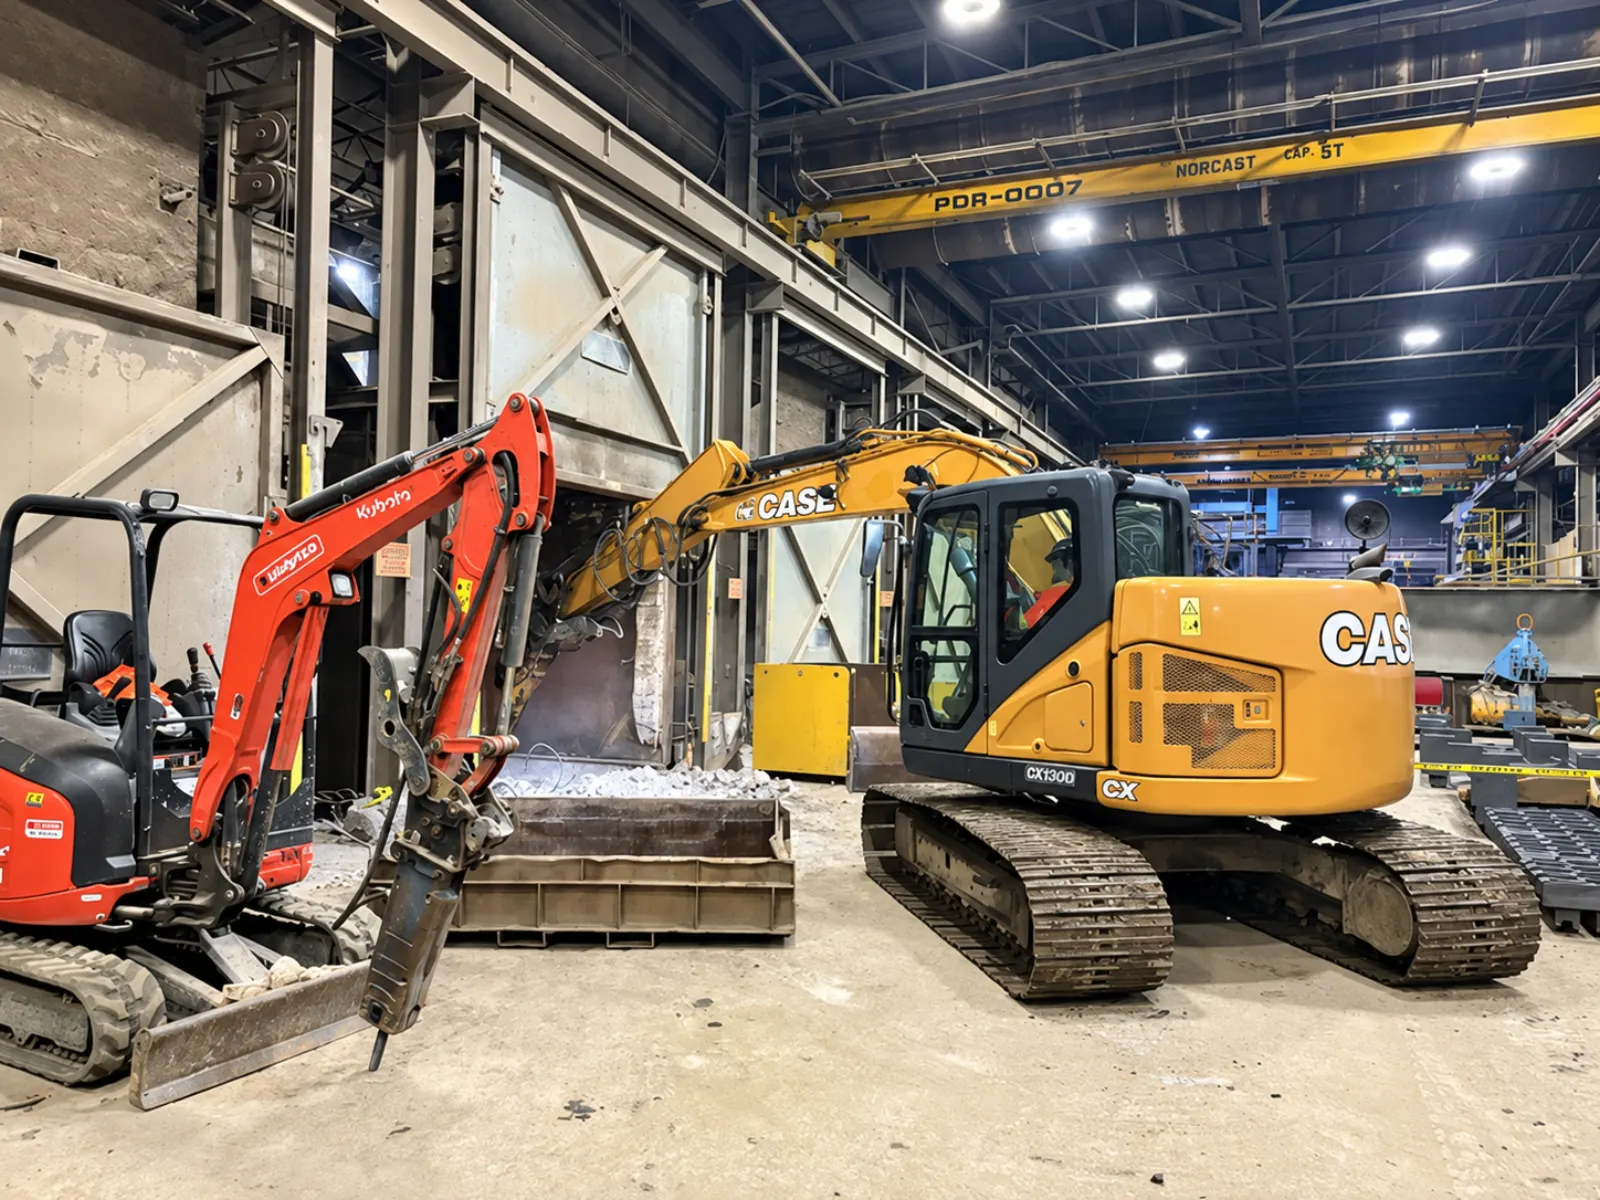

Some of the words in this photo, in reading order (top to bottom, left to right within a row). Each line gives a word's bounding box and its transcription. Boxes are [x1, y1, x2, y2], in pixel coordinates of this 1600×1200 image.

[1283, 146, 1315, 160] CAP.
[1320, 143, 1344, 160] 5T
[1176, 155, 1256, 178] NORCAST
[934, 179, 1083, 211] PDR-0007
[758, 483, 837, 520] CASE
[1319, 609, 1414, 667] CAS
[1026, 765, 1075, 785] CX130D
[1102, 778, 1141, 801] CX
